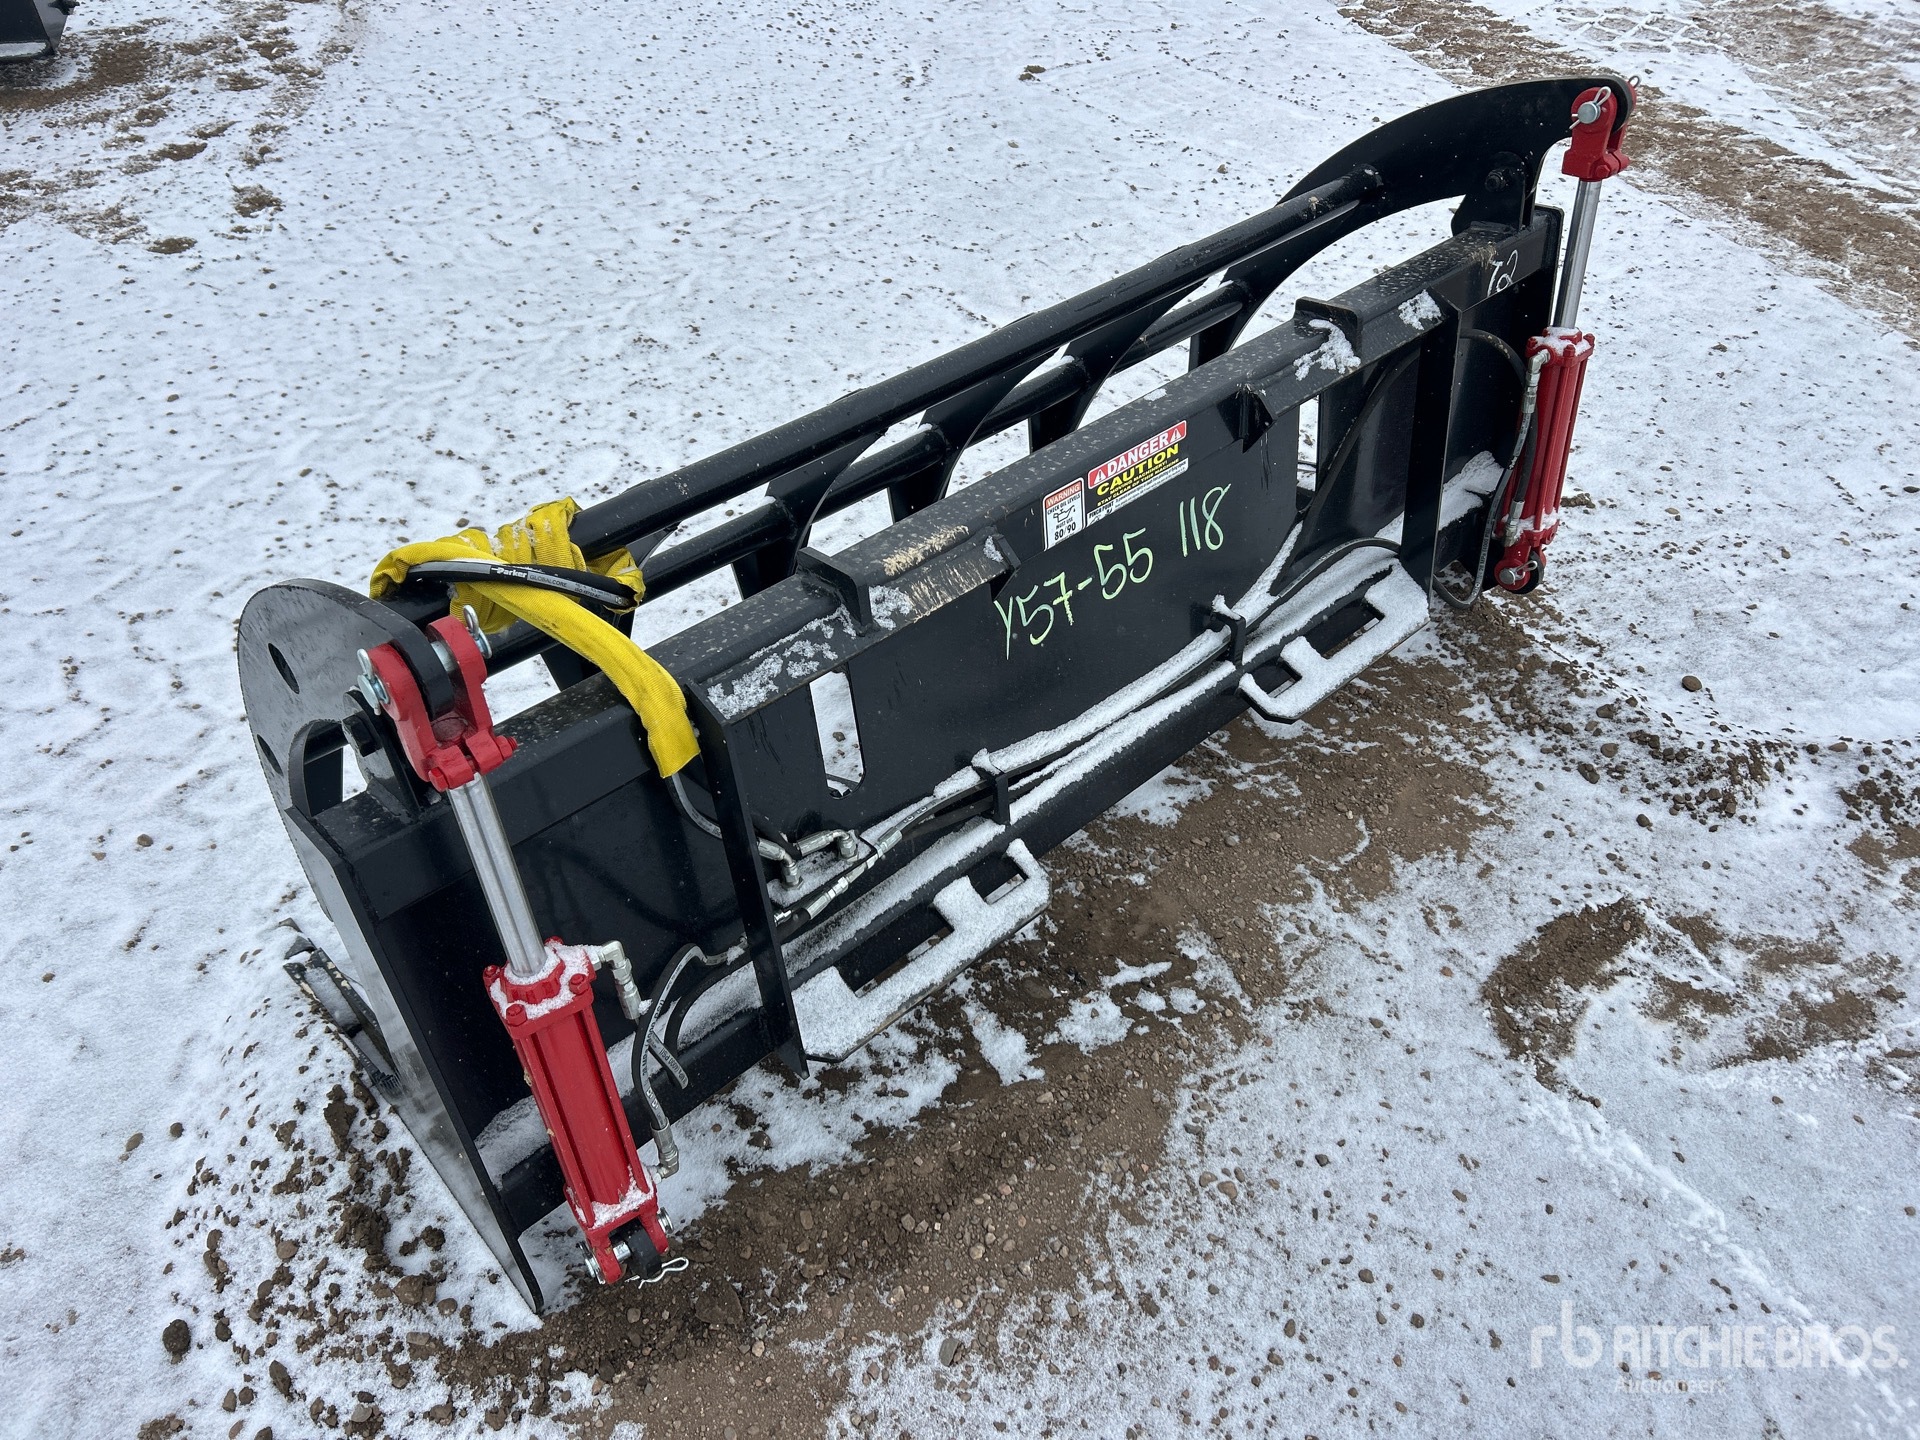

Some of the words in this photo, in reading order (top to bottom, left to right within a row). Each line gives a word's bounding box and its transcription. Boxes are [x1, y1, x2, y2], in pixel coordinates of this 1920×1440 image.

[1106, 432, 1169, 476] DANGER
[1096, 443, 1179, 496] CAUTION
[1097, 496, 1112, 506] STAY
[1112, 486, 1132, 498] CLEAR
[1132, 481, 1140, 489] OF
[1154, 458, 1179, 476] MACHINE
[1109, 479, 1133, 494] MOVING
[1047, 485, 1080, 506] WARNING
[1047, 504, 1060, 515] CHECK
[1067, 493, 1081, 504] LEVELS
[1088, 507, 1102, 519] PINCH
[1102, 501, 1114, 512] POINT
[1055, 520, 1066, 530] MUST
[1178, 483, 1232, 558] 118
[1054, 521, 1077, 541] 80/90
[496, 567, 528, 578] Parker
[530, 575, 567, 588] GLOBALCORE
